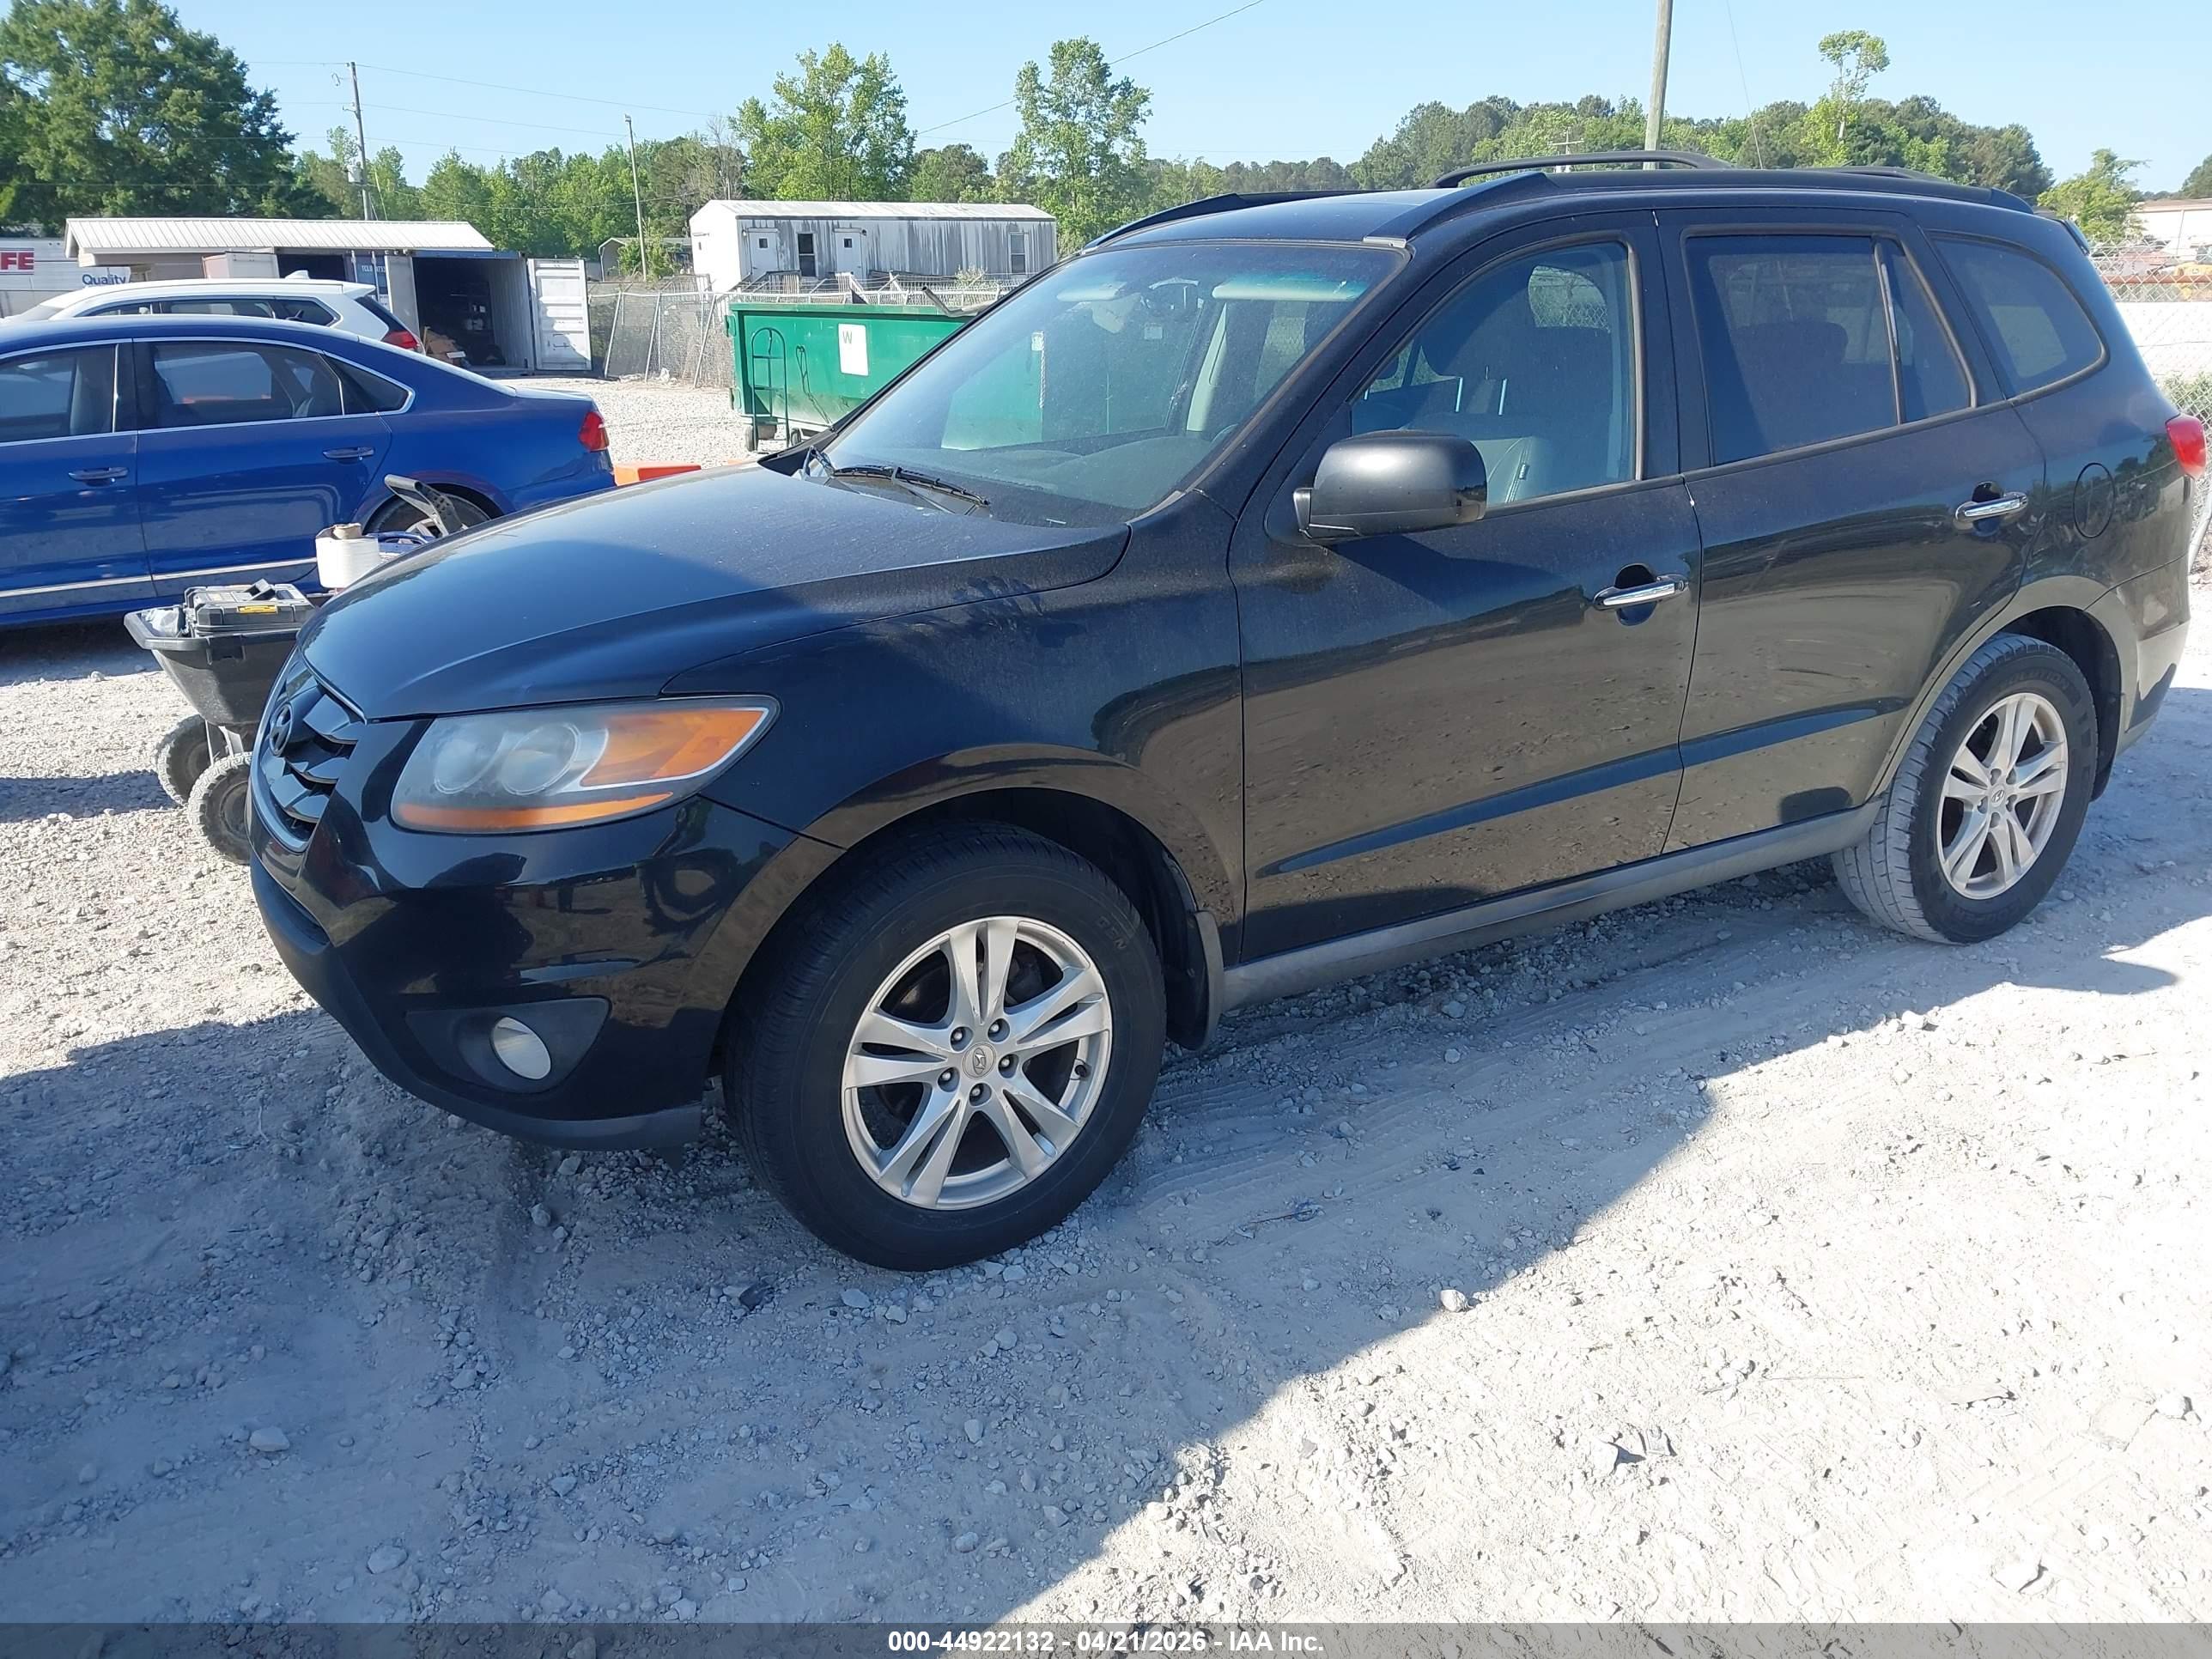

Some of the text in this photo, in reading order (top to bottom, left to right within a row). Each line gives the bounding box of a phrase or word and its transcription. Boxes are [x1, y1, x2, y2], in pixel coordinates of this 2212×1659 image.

[1, 252, 34, 270] FE
[82, 274, 126, 285] Quality
[842, 331, 853, 344] W
